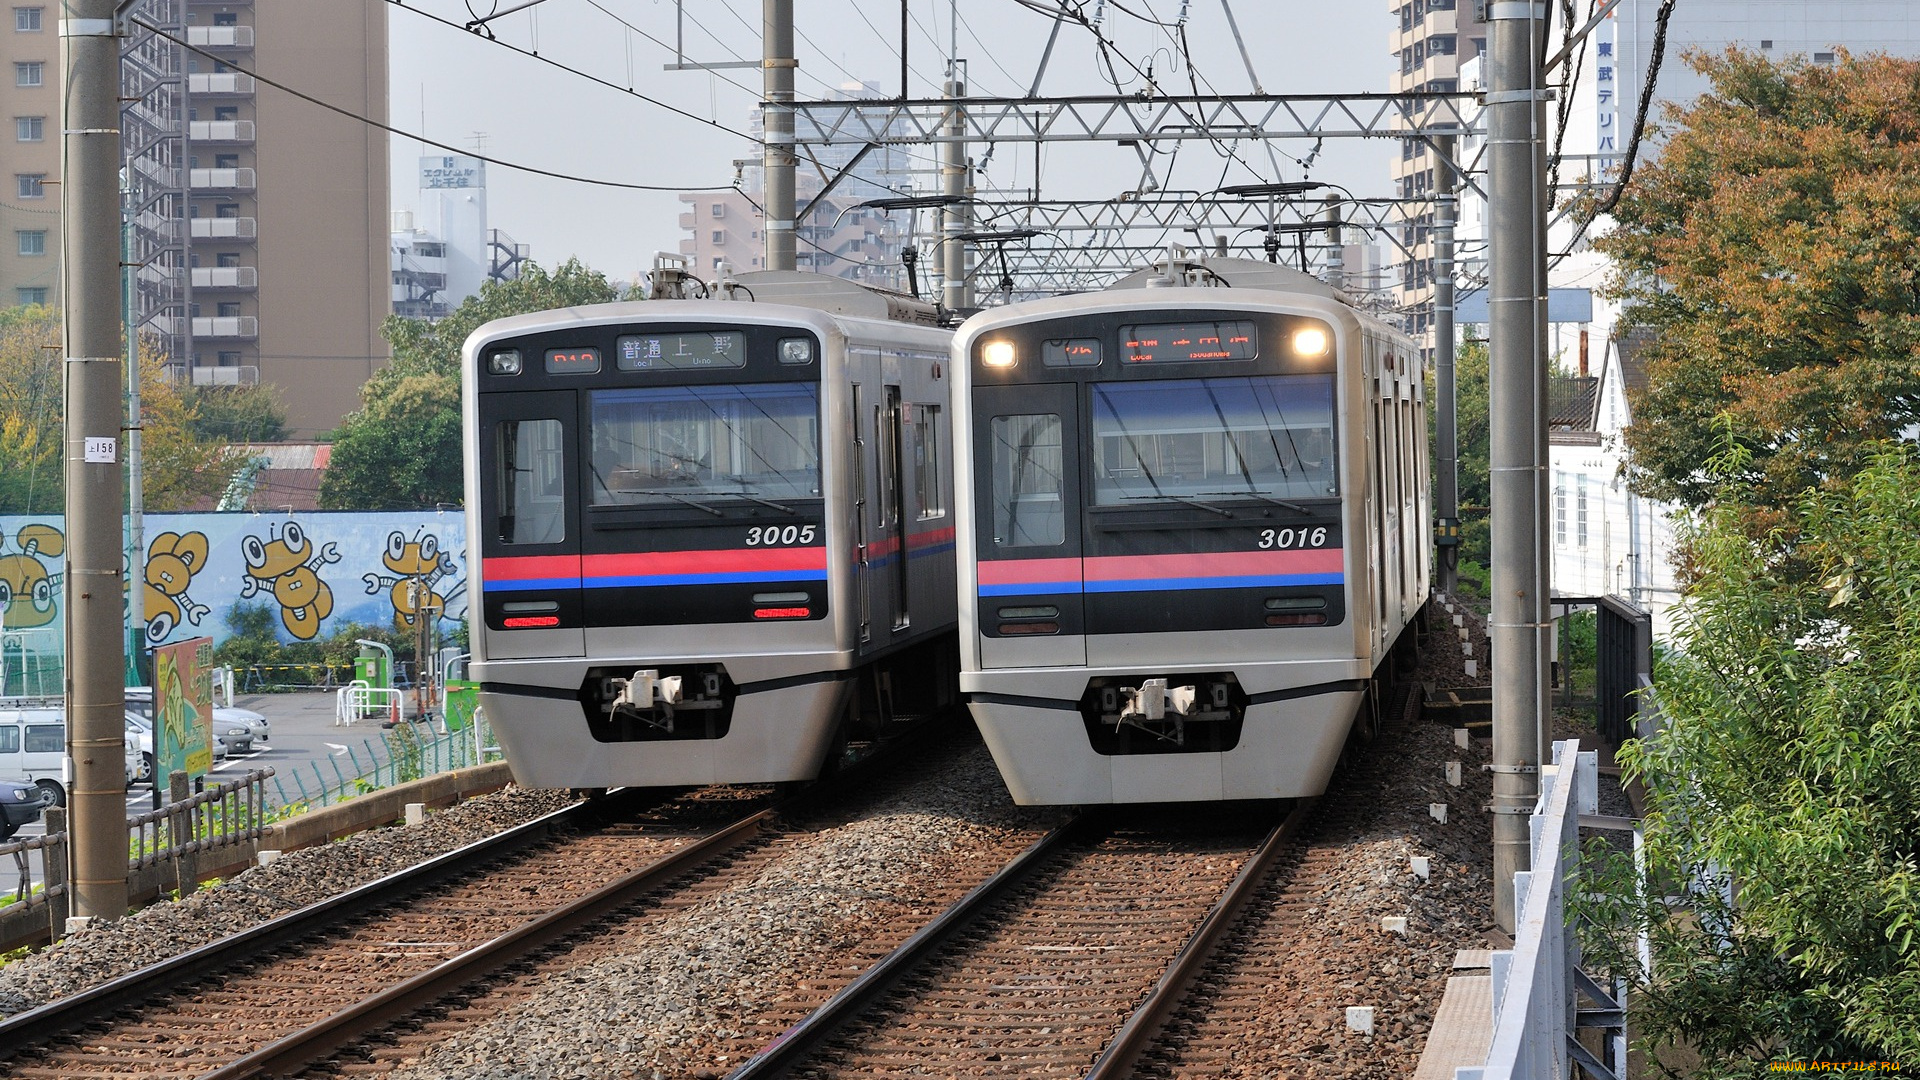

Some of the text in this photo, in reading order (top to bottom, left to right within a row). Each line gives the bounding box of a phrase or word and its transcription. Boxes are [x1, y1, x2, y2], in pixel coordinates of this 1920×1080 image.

[429, 177, 469, 187] 北千住
[745, 524, 817, 546] 3005
[1258, 526, 1327, 549] 3016
